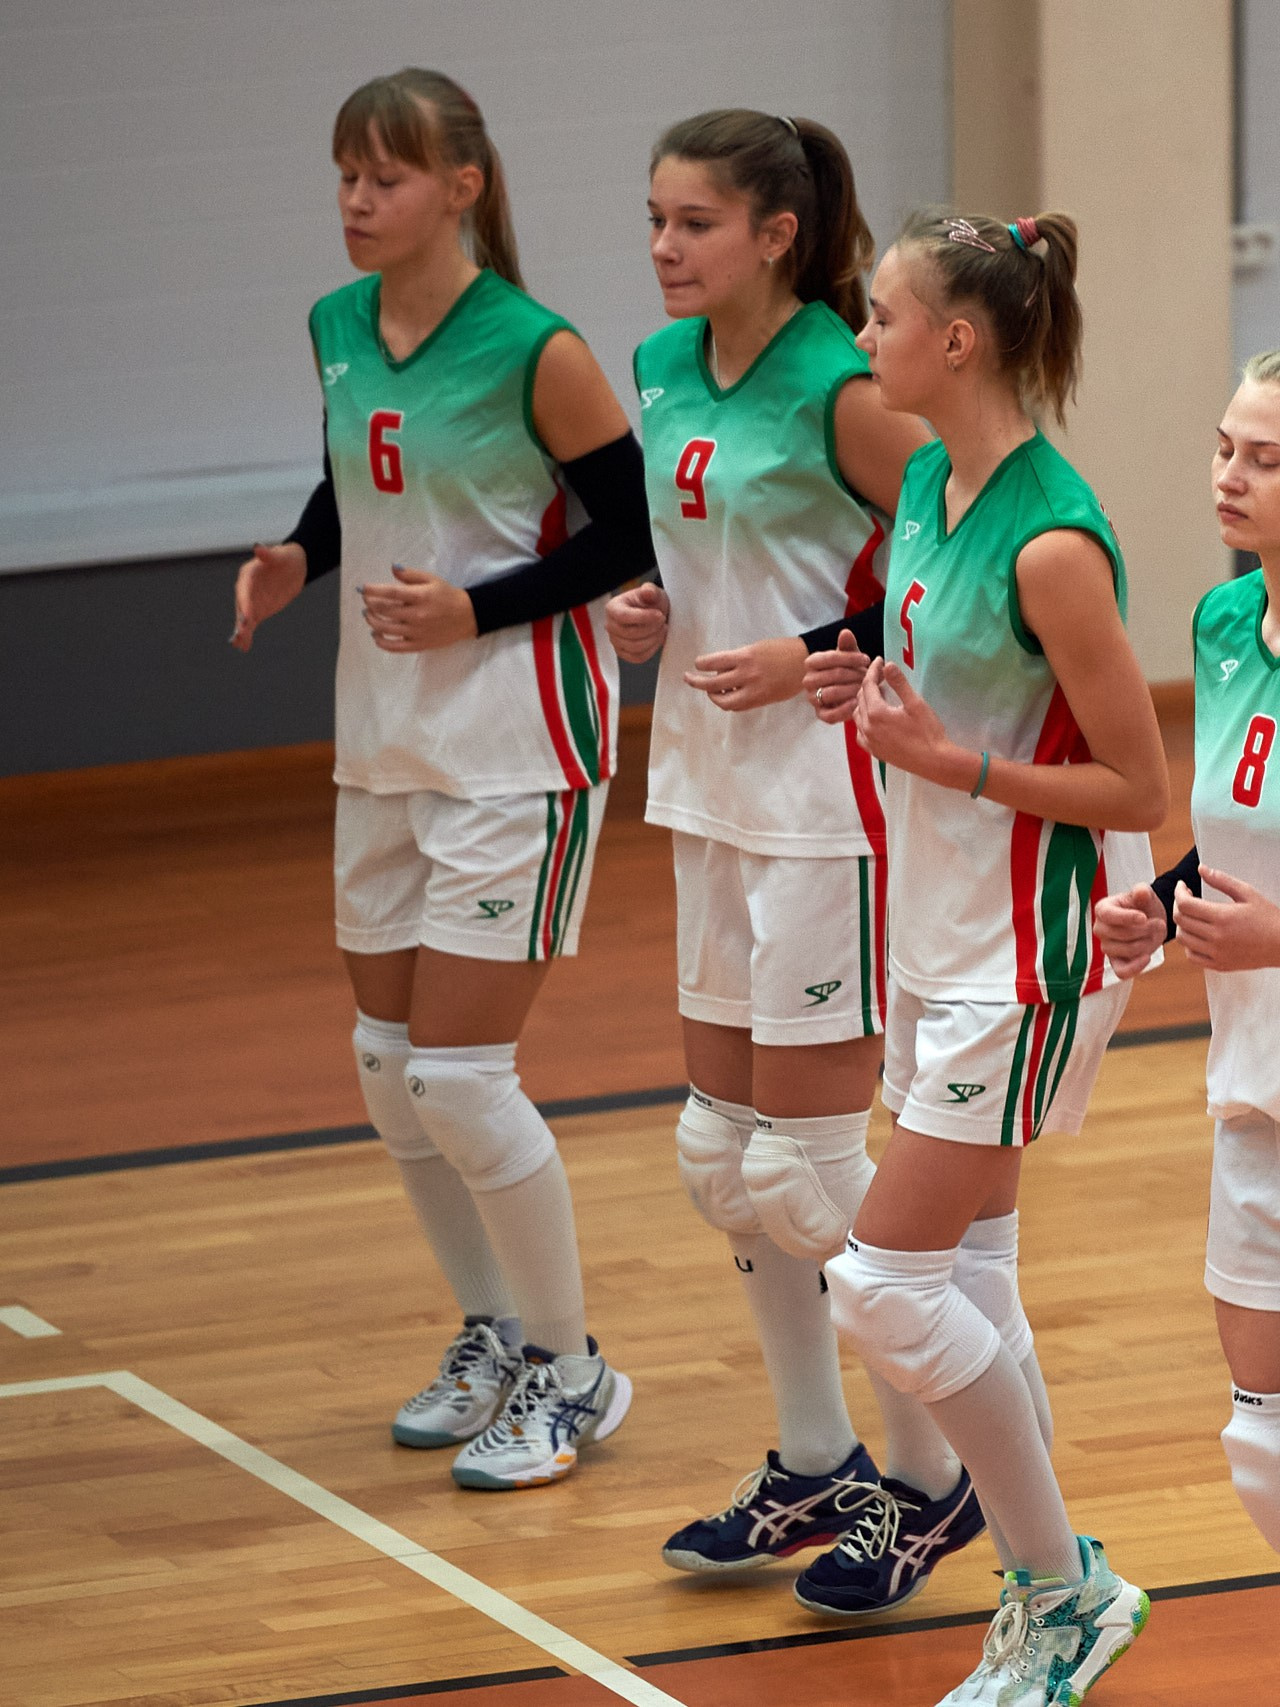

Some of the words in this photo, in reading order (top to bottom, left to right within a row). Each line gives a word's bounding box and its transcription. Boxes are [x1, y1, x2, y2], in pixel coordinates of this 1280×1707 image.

[367, 409, 405, 495] 6
[673, 437, 717, 520] 9
[900, 579, 927, 671] 5
[1232, 712, 1278, 808] 8
